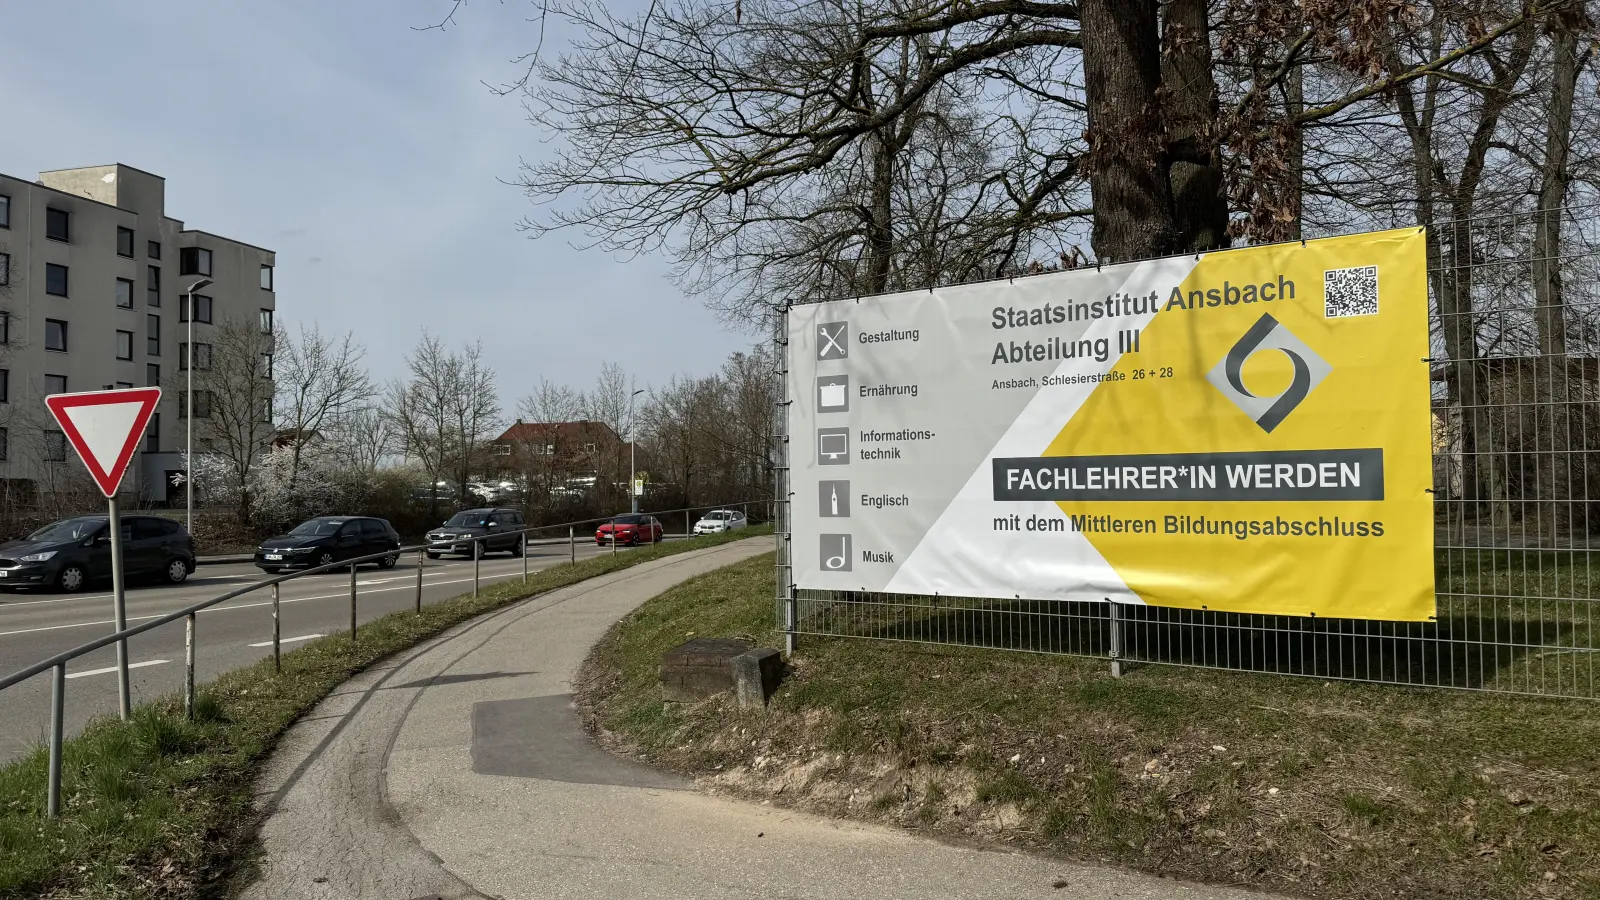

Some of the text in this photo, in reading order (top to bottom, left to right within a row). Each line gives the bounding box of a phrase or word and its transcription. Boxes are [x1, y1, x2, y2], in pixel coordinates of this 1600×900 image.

[992, 275, 1295, 330] Staatsinstitut Ansbach
[858, 329, 920, 344] Gestaltung
[992, 329, 1140, 365] Abteilung III
[992, 377, 1040, 390] Ansbach,
[1041, 370, 1126, 387] Schlesierstraße
[1132, 369, 1146, 380] 26
[1159, 367, 1173, 378] 28
[859, 383, 918, 398] Ernährung
[860, 429, 936, 443] Informations-
[860, 447, 901, 460] technik
[1225, 463, 1361, 489] WERDEN
[861, 494, 909, 509] Englisch
[993, 514, 1385, 540] mit dem Mittleren Bildungsabschluss
[862, 550, 894, 563] Musik
